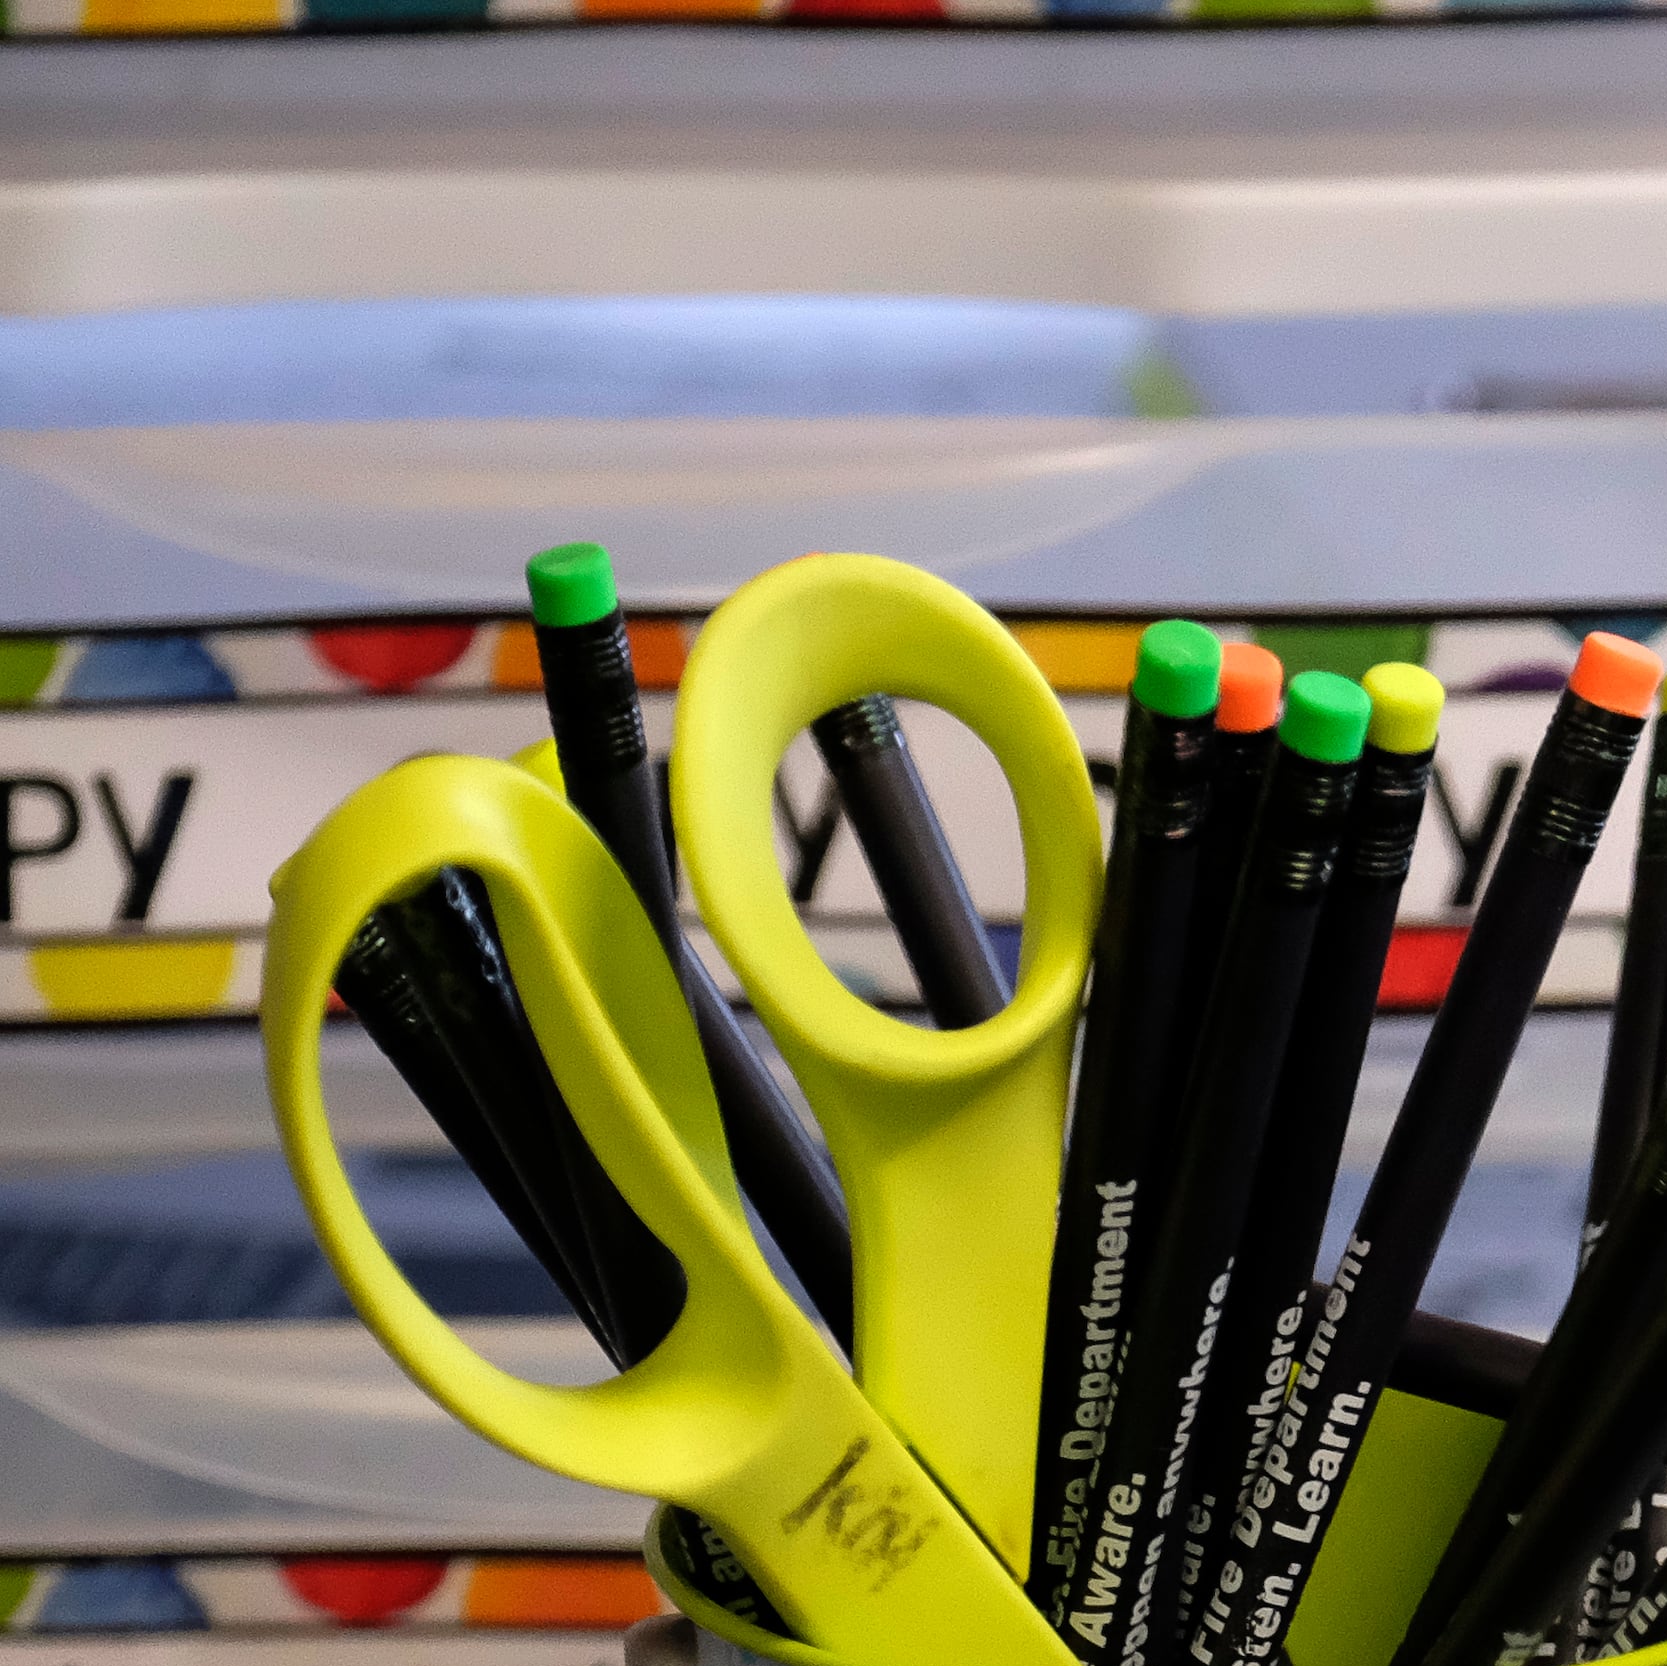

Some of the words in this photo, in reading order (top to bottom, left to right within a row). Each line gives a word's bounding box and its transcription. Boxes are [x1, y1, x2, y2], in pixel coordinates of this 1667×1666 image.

[1190, 1559, 1244, 1666] Fire
[1233, 1231, 1372, 1548] Department
[1273, 1380, 1372, 1544] Learn.
[1069, 1472, 1147, 1648] Aware.
